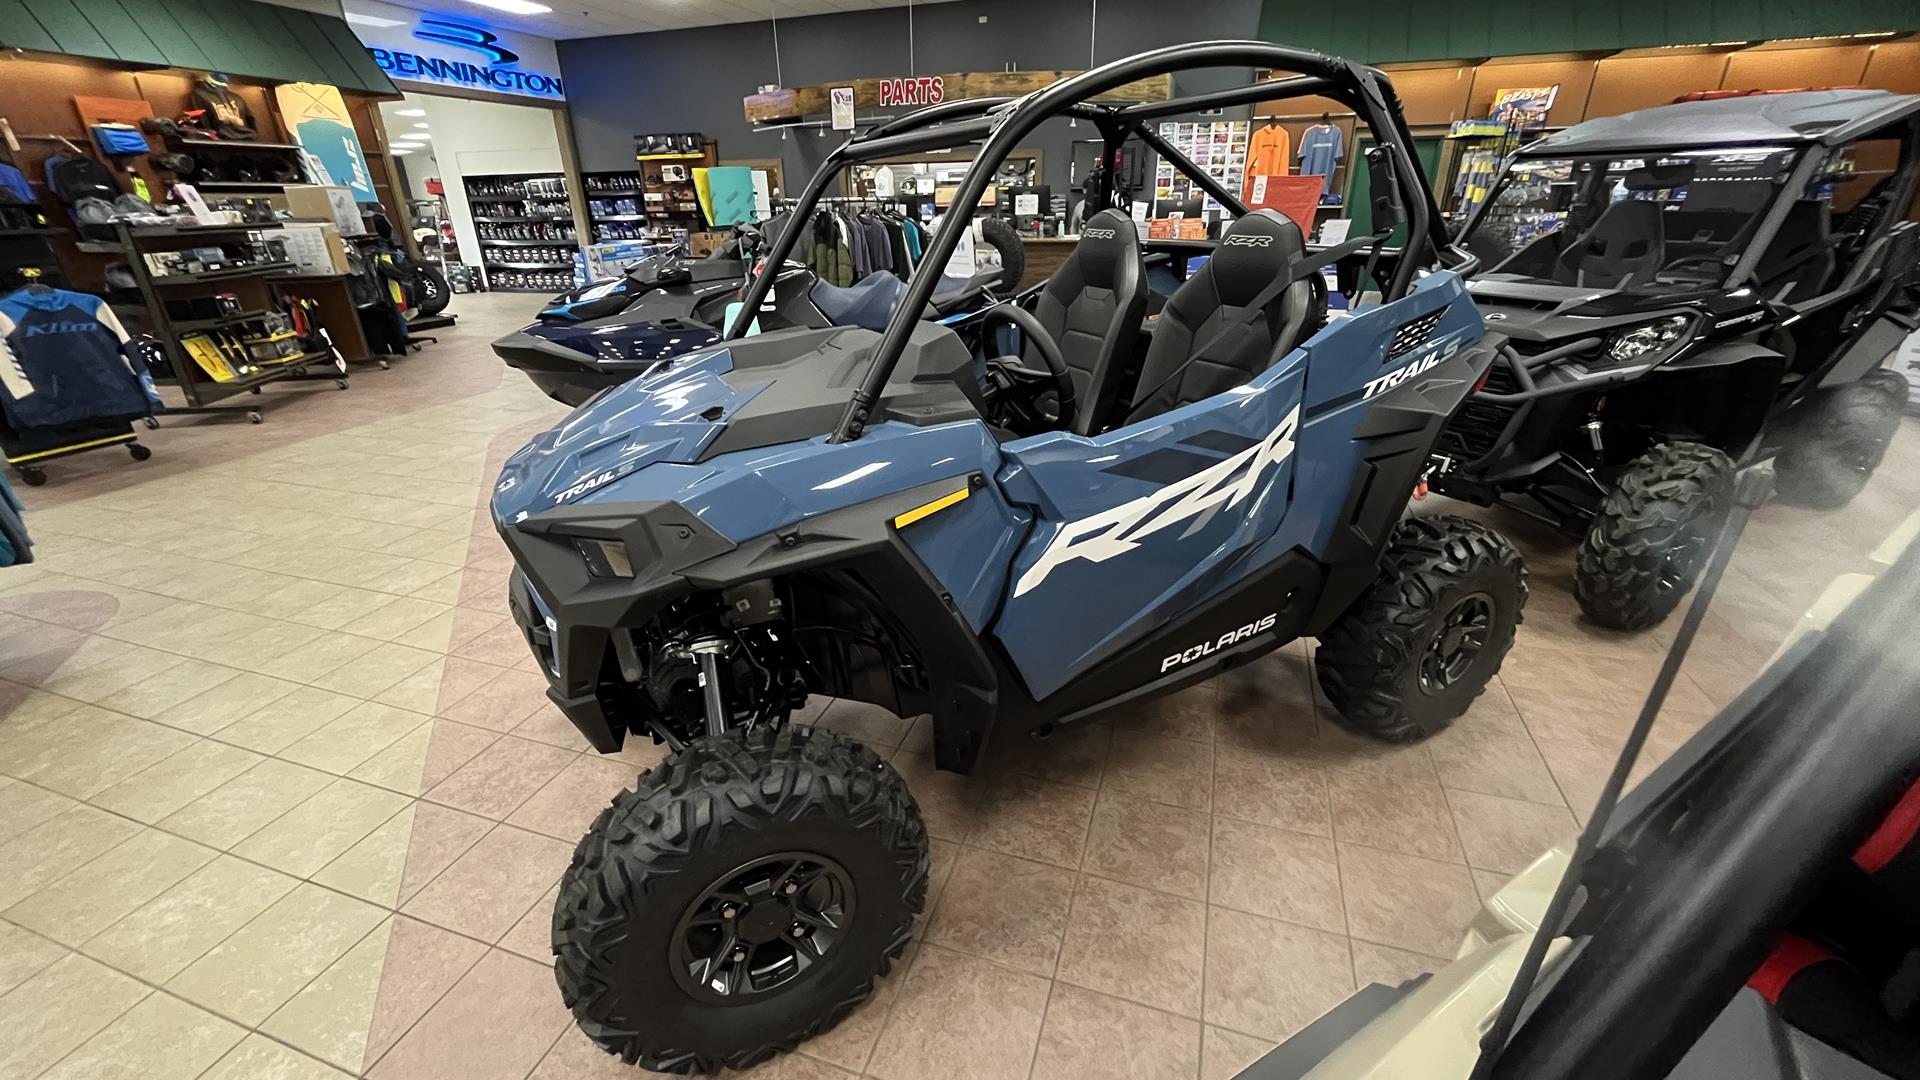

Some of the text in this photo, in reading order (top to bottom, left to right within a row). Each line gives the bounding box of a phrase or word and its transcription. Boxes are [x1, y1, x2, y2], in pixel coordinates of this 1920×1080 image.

[372, 47, 563, 96] BENNINGTON
[879, 76, 944, 107] PARTS
[1084, 228, 1116, 239] RZR
[1223, 234, 1274, 248] RZR
[1362, 336, 1462, 400] TRAIL S
[554, 461, 636, 504] TRAIL S
[1013, 402, 1301, 598] RZR
[1160, 612, 1278, 673] POLARIS
